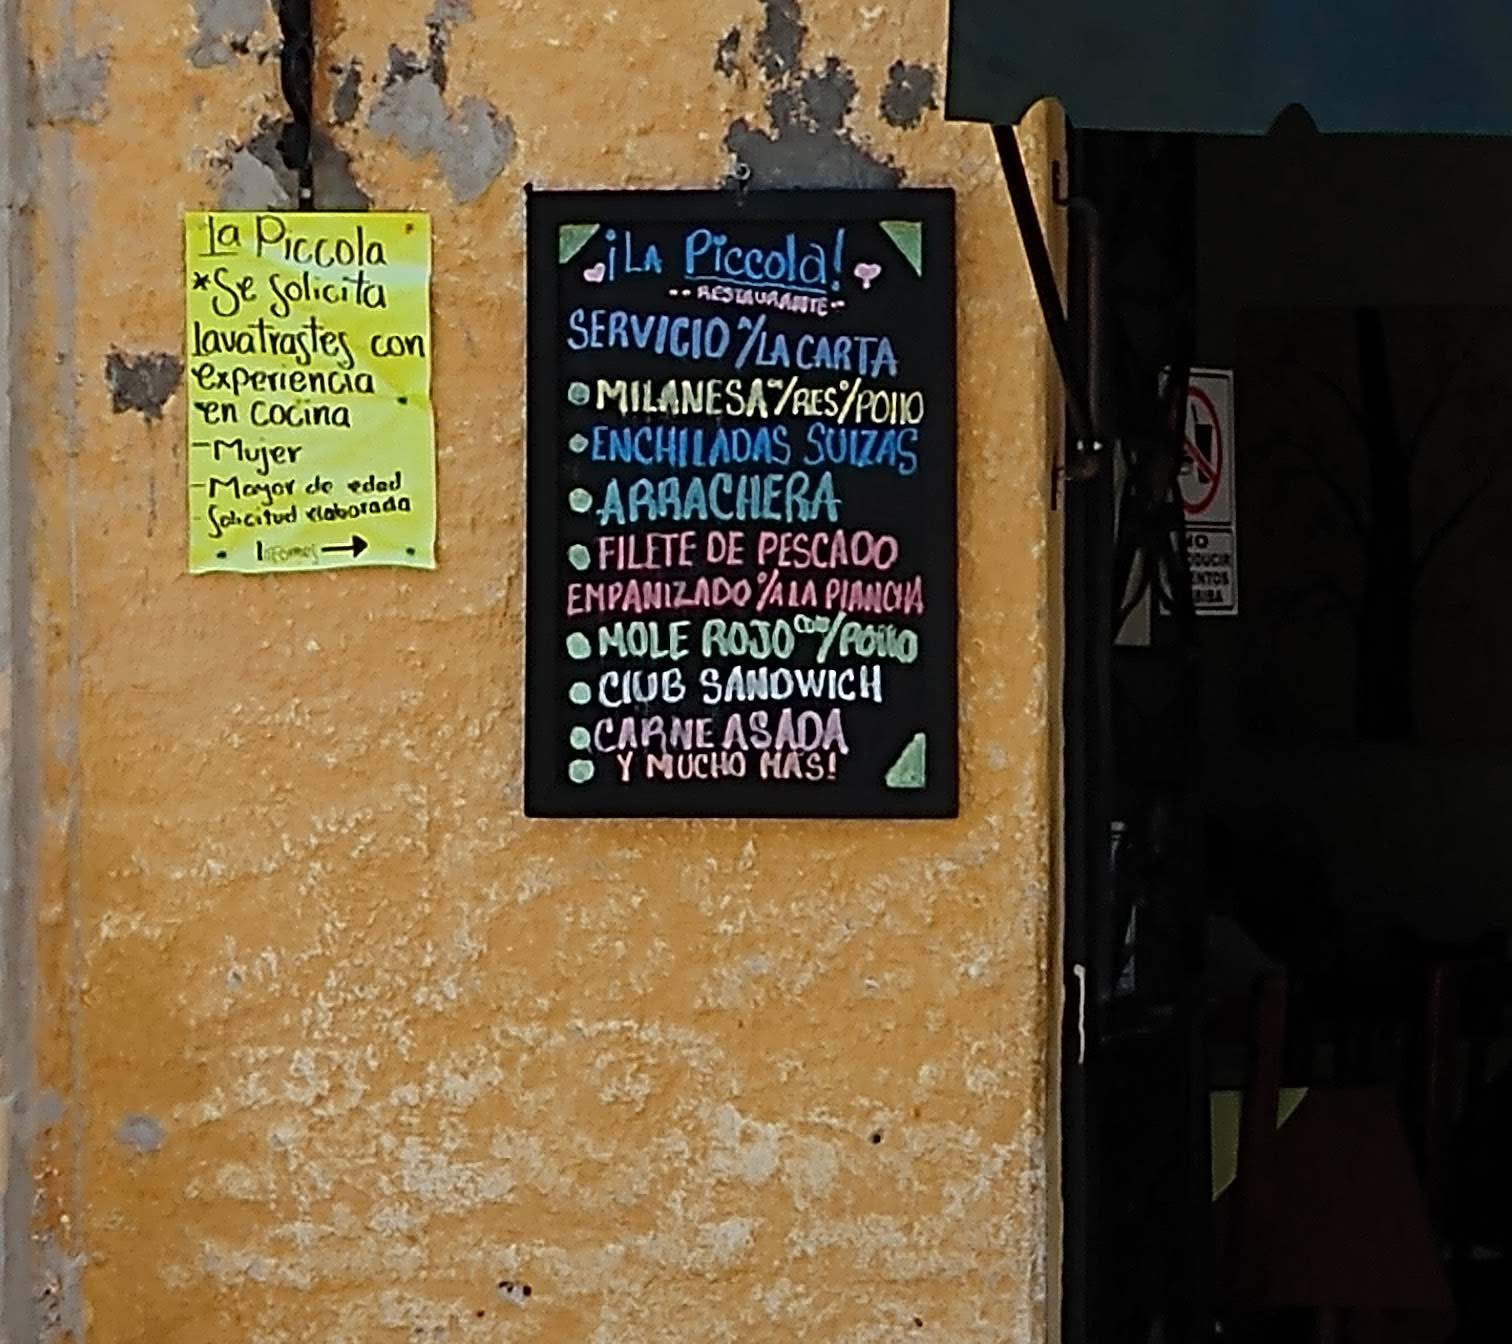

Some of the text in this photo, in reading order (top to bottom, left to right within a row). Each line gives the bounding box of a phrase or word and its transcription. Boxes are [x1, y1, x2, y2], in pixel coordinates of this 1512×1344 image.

[256, 214, 388, 267] Piccola
[685, 227, 846, 292] Piccola!
[371, 334, 426, 358] con
[567, 310, 731, 360] SERVICIO
[795, 333, 899, 379] CARTA
[191, 362, 375, 397] experiencia
[596, 377, 769, 419] MILANESA
[194, 400, 238, 425] en
[591, 421, 920, 476] ENCHILADAS SUIZAS
[305, 475, 333, 494] de
[348, 471, 401, 493] edad
[596, 470, 842, 526] ARRACHERA
[599, 529, 899, 570] FILETE DE PESCADO
[567, 576, 752, 616] EMPANIZADO
[598, 619, 692, 661] MOLE
[701, 617, 796, 660] ROJO
[699, 664, 883, 706] SANDWICH
[593, 707, 850, 756] CARNE ASADA
[616, 751, 634, 782] Y
[646, 751, 747, 780] MUCHO
